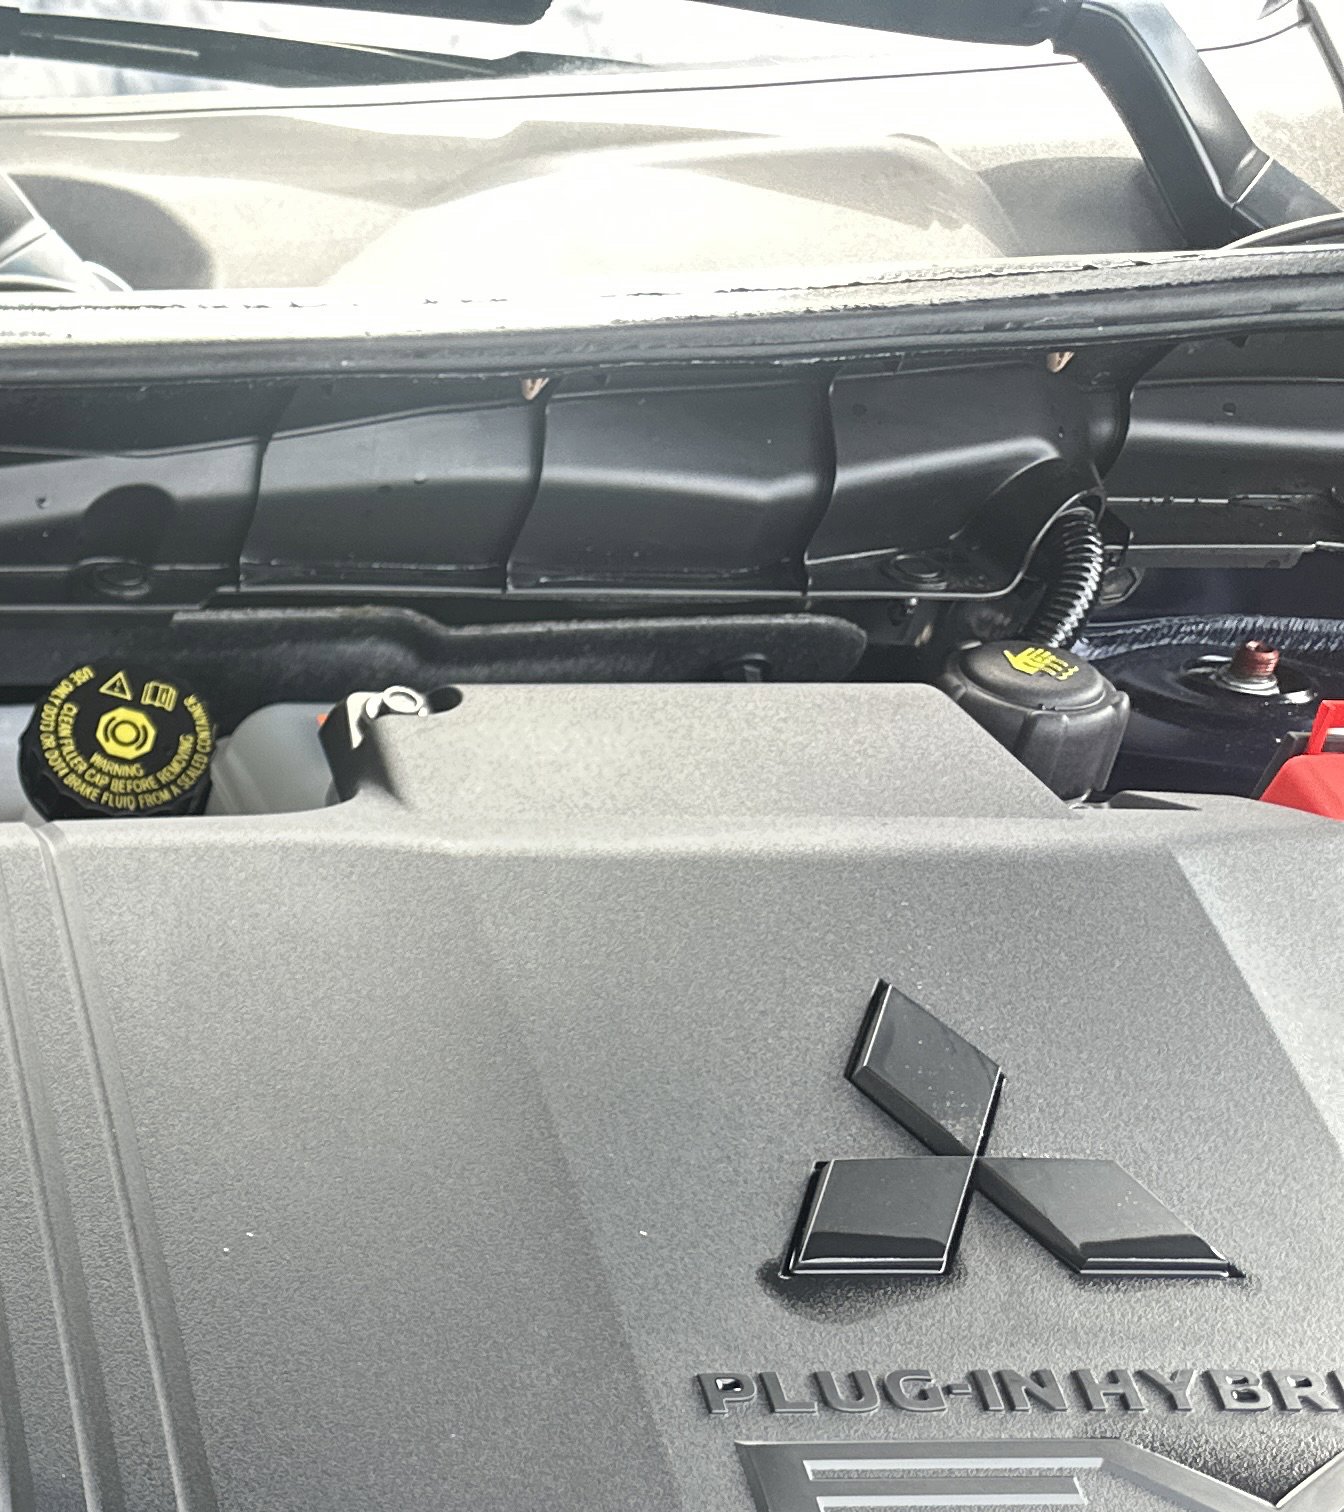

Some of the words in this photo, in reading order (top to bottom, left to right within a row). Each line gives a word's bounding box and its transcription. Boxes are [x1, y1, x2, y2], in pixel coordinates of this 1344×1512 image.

[69, 665, 95, 686] USE
[48, 679, 74, 705] ONLY
[58, 702, 78, 737] CLEAN
[184, 694, 212, 753] CONTAINER
[39, 732, 57, 750] OR
[44, 750, 70, 778] DOT4
[60, 738, 88, 774] FILLER
[89, 752, 144, 777] WARNING
[156, 733, 195, 783] REMOVING
[84, 768, 110, 786] CAP
[110, 775, 159, 793] BEFORE
[177, 753, 208, 789] SEALED
[63, 773, 101, 802] BRAKE
[138, 788, 172, 809] FROM
[170, 785, 182, 796] A
[101, 792, 136, 811] FLUID
[696, 1369, 1069, 1415] PLUG-IN
